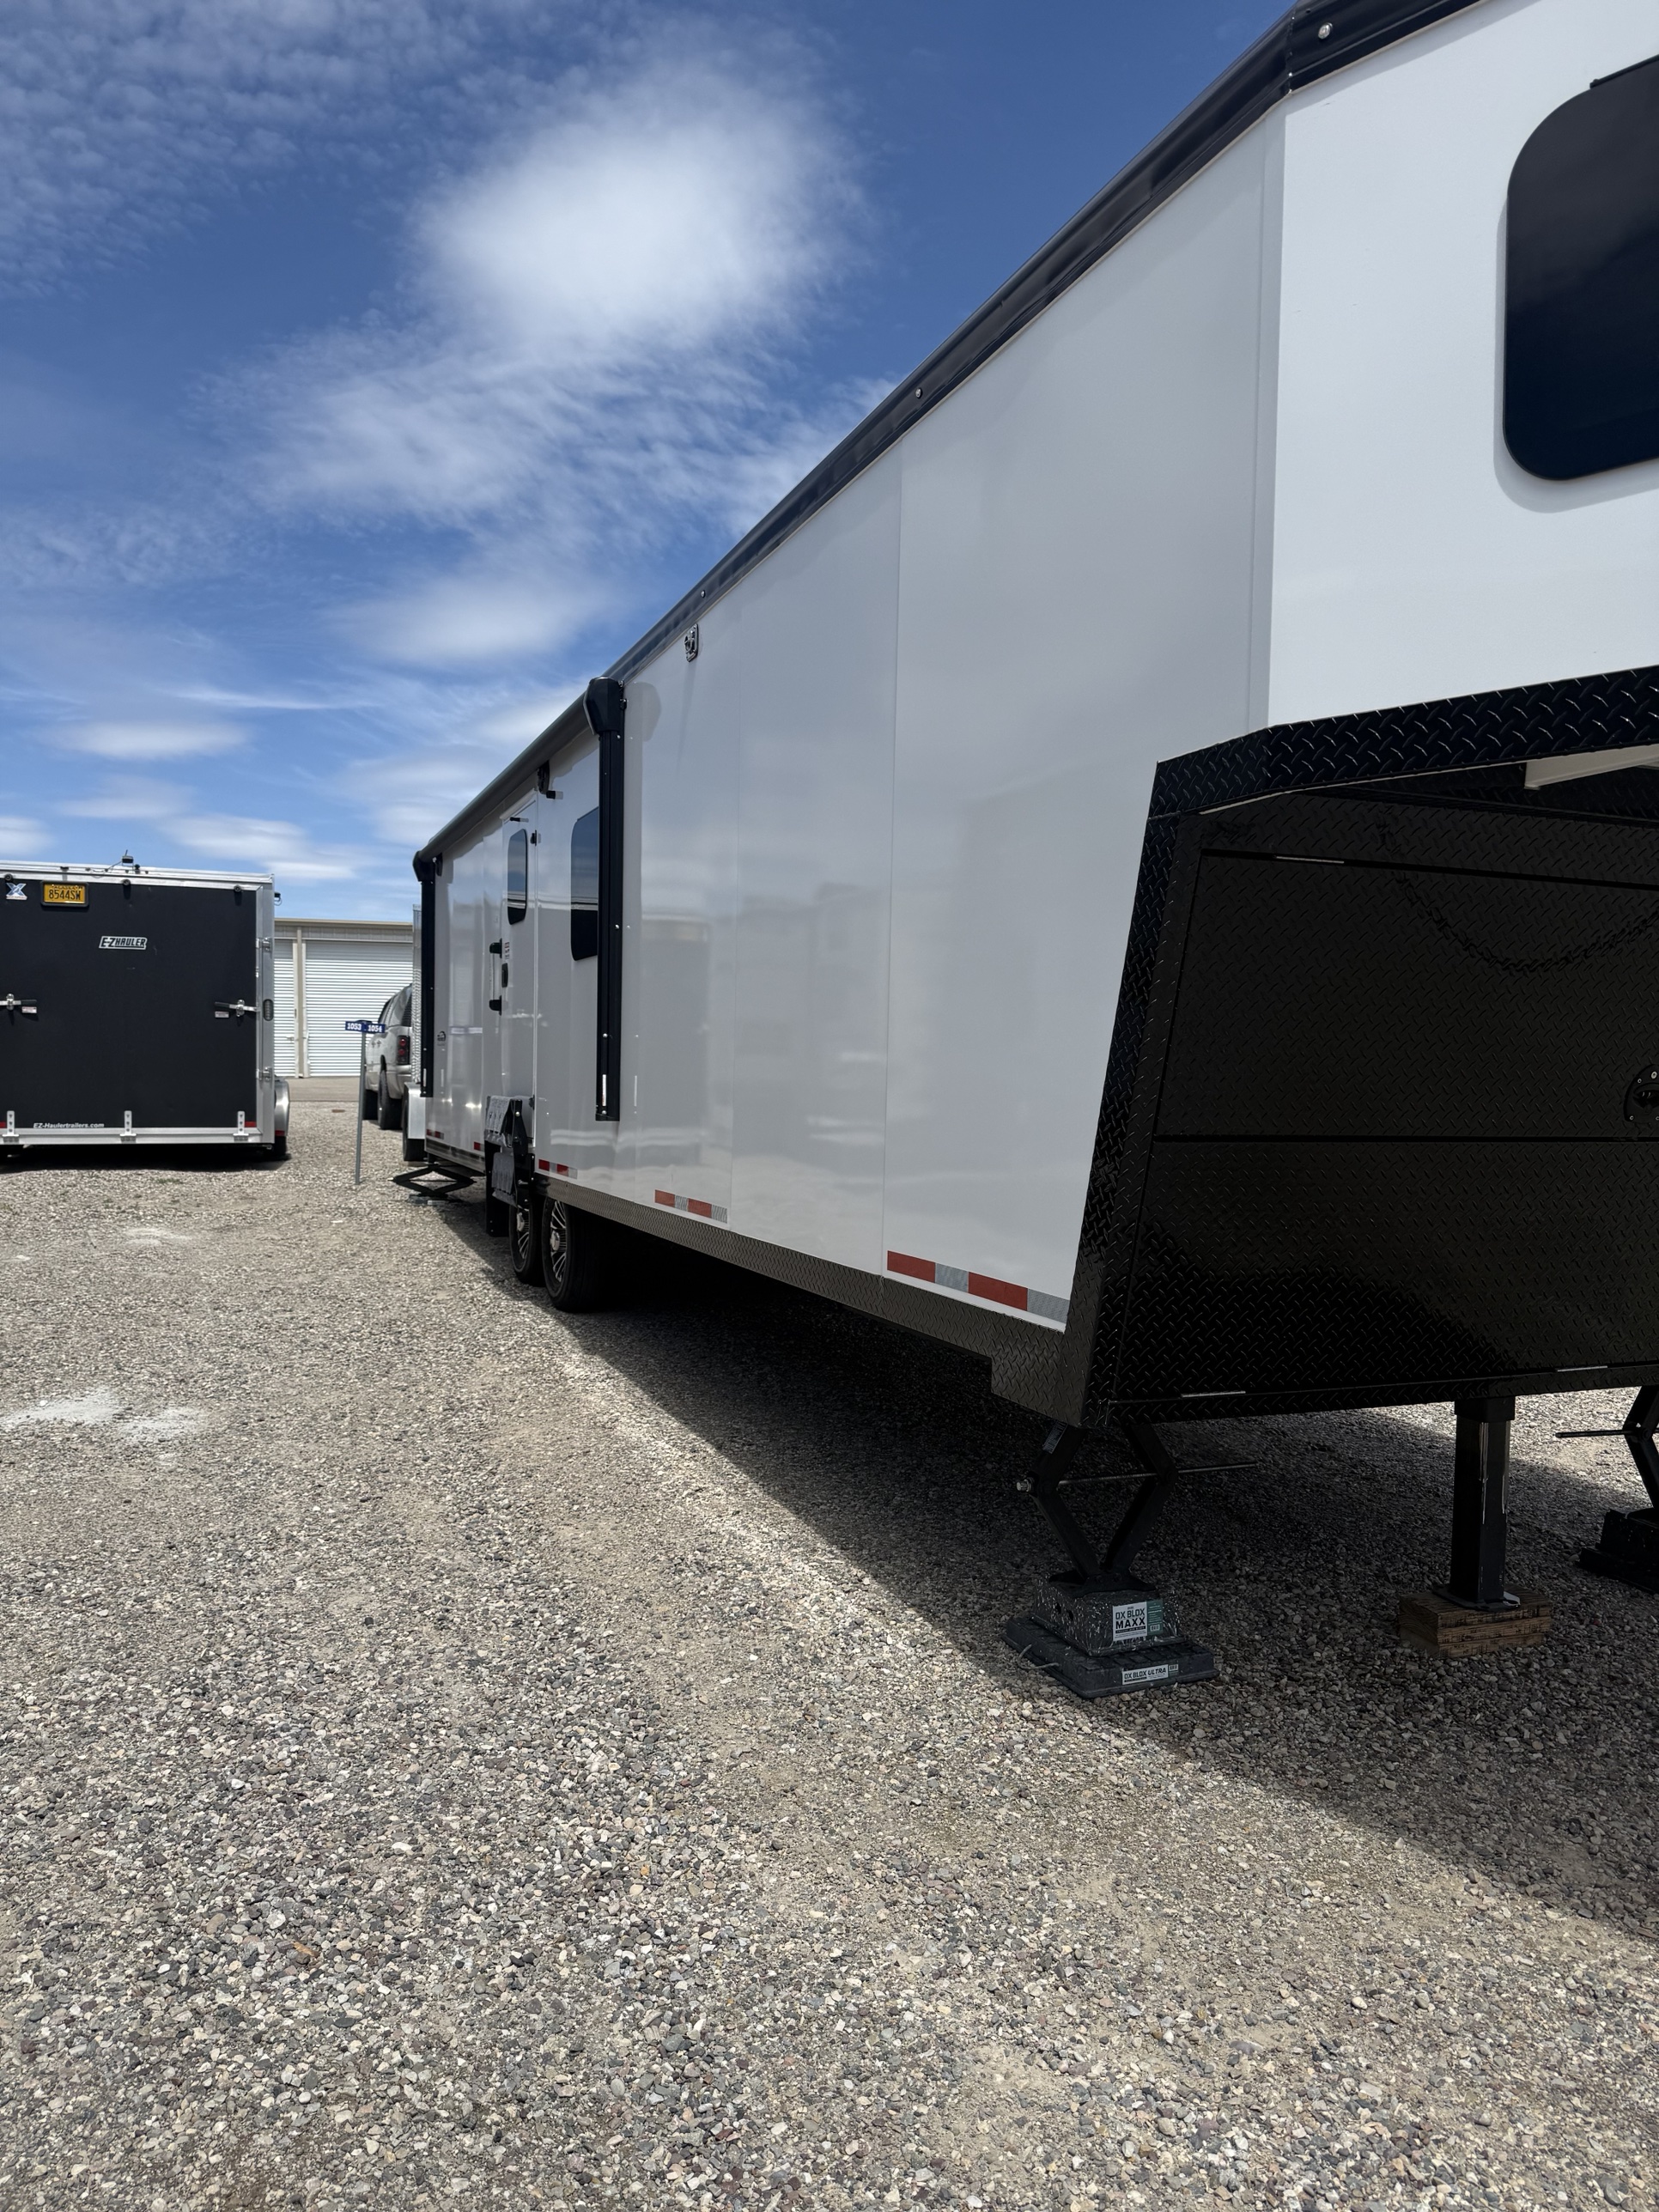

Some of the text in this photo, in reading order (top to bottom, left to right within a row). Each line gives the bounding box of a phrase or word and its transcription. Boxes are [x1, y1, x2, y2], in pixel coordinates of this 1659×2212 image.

[1115, 1611, 1126, 1620] OX
[1127, 1608, 1146, 1618] BLOX
[1115, 1617, 1146, 1629] MAXX
